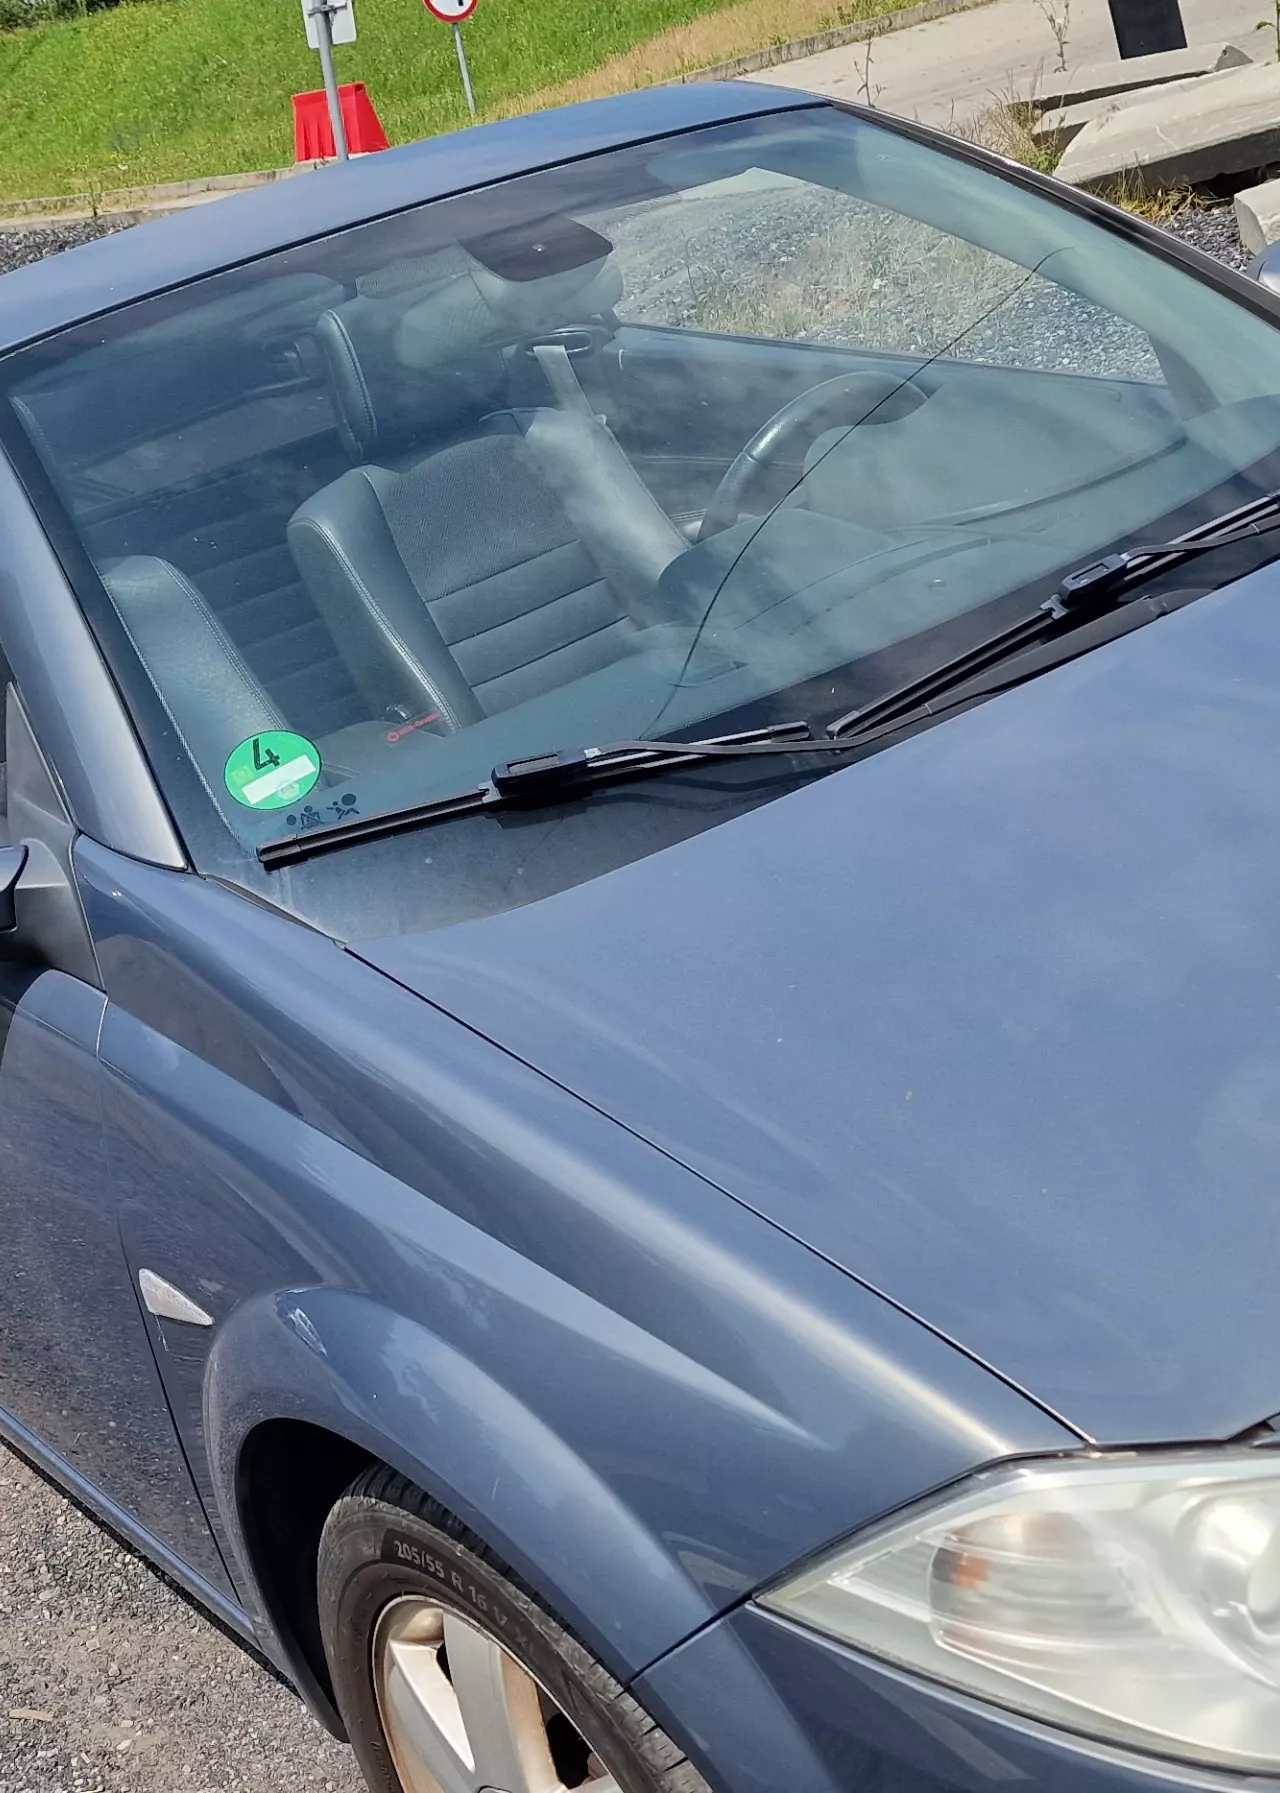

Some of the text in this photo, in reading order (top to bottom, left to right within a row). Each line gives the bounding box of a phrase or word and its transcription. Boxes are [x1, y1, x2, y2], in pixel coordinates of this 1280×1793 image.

[252, 737, 280, 771] 4
[393, 1540, 445, 1579] 205/55
[451, 1571, 464, 1593] R
[469, 1585, 488, 1611] 16
